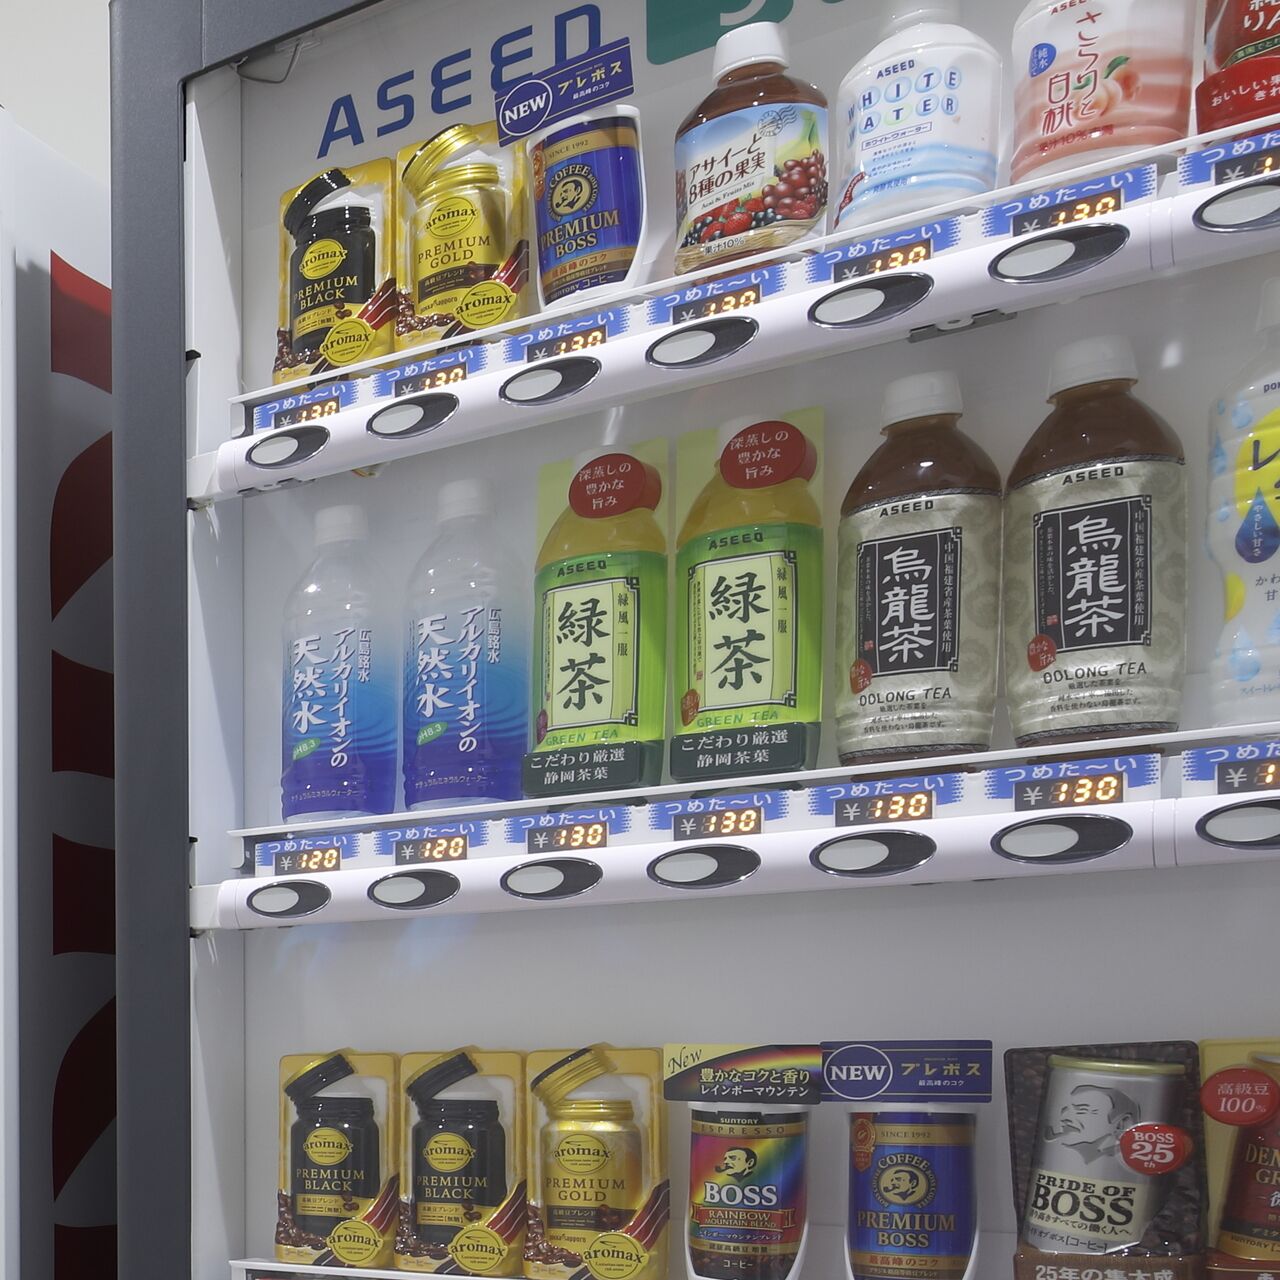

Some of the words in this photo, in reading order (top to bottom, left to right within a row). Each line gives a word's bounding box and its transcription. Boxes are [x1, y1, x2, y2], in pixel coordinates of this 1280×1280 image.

[1076, 11, 1102, 116] さらりと
[557, 59, 622, 95] プレボス
[503, 92, 547, 125] NEW
[690, 133, 763, 183] アサイーと
[689, 152, 765, 204] 8種の果実
[417, 235, 491, 263] PREMIUM
[555, 232, 597, 259] BOSS
[430, 250, 474, 269] GOLD
[300, 289, 344, 310] BLACK
[729, 431, 788, 451] 深蒸しの
[738, 447, 781, 463] 豊かな
[578, 463, 631, 482] 深蒸しの
[745, 466, 774, 479] 旨み
[1062, 466, 1124, 485] ASEED
[586, 478, 624, 494] 豊かな
[592, 494, 618, 509] 旨み
[879, 500, 934, 517] ASEED
[1063, 515, 1127, 639] 烏龍茶
[776, 566, 787, 634] 緑風一服
[881, 547, 936, 664] 烏龍茶
[941, 541, 955, 654] 中国福建省産茶葉使用
[617, 592, 628, 657] 緑風一服
[709, 572, 771, 691] 緑茶
[487, 609, 502, 664] 広島銘水
[358, 629, 371, 683] 広島銘水
[556, 598, 610, 711] 緑茶
[416, 614, 457, 719] 天然水
[1043, 664, 1108, 685] OOLONG
[1117, 661, 1147, 676] TEA
[292, 635, 330, 734] 天然水
[457, 605, 485, 753] アルカリイオンの
[329, 627, 356, 768] アルカリイオンの
[859, 689, 919, 706] OOLONG
[922, 686, 952, 700] TEA
[696, 711, 744, 727] GREEN
[546, 730, 587, 746] GREEN
[591, 728, 619, 740] TEA
[681, 729, 788, 751] こだわり厳選
[529, 748, 625, 769] こだわり厳選
[696, 749, 769, 767] 静岡茶葉
[544, 767, 608, 784] 静岡茶葉
[668, 1047, 703, 1075] New
[900, 1062, 981, 1076] プレボス
[700, 1068, 811, 1085] 豊かなコクと香り
[830, 1065, 887, 1081] NEW
[700, 1084, 810, 1097] レインボーマウンテン
[1218, 1083, 1269, 1095] 高級豆
[881, 1130, 908, 1139] SINCE
[1131, 1142, 1174, 1162] 25
[878, 1154, 929, 1171] COFFEE
[296, 1168, 365, 1180] PREMIUM
[417, 1176, 488, 1188] PREMIUM
[305, 1180, 352, 1192] BLACK
[425, 1188, 473, 1199] BLACK
[704, 1182, 778, 1206] BOSS
[1037, 1172, 1096, 1194] PRIDE
[1102, 1185, 1136, 1198] OF
[558, 1190, 607, 1202] GOLD
[1030, 1184, 1135, 1226] BOSS
[708, 1211, 770, 1221] RAINBOW
[857, 1212, 957, 1231] PREMIUM
[327, 1233, 383, 1248] aromax
[877, 1232, 929, 1247] BOSS
[450, 1243, 509, 1257] aromax
[583, 1247, 645, 1265] aromax
[723, 1259, 753, 1269] コーヒー
